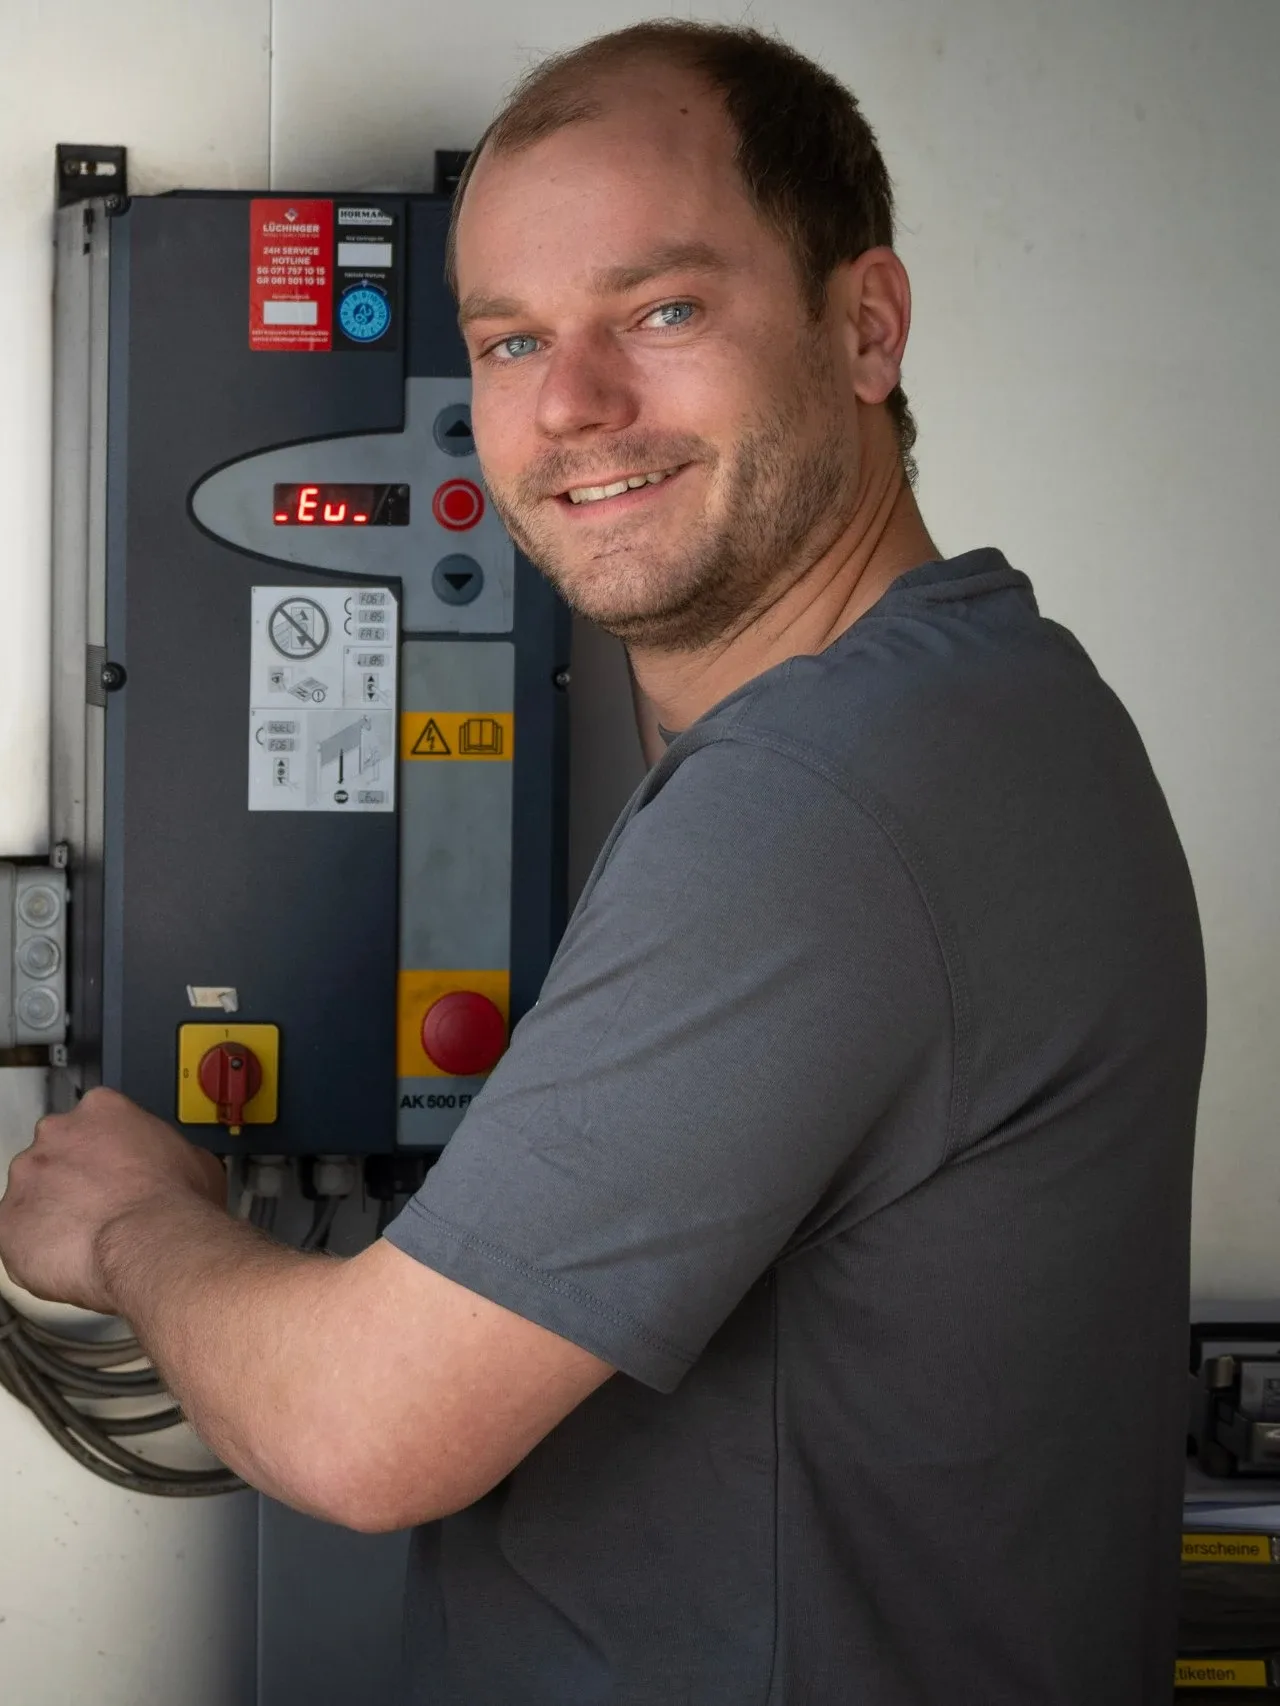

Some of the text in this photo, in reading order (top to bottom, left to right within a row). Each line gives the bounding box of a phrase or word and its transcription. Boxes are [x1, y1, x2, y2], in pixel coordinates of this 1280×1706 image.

[263, 221, 320, 233] LÜCHINGER
[263, 247, 320, 255] 24H SERVICE
[272, 257, 311, 265] HOTLINE
[256, 266, 269, 275] SG
[270, 266, 285, 275] 071
[304, 266, 315, 275] 10
[316, 266, 326, 275] 15
[256, 276, 269, 285] GR
[304, 276, 315, 285] 10
[400, 1094, 425, 1109] AK
[427, 1094, 456, 1109] 500
[1181, 1541, 1260, 1556] erscheine
[1175, 1667, 1236, 1681] tiketten
